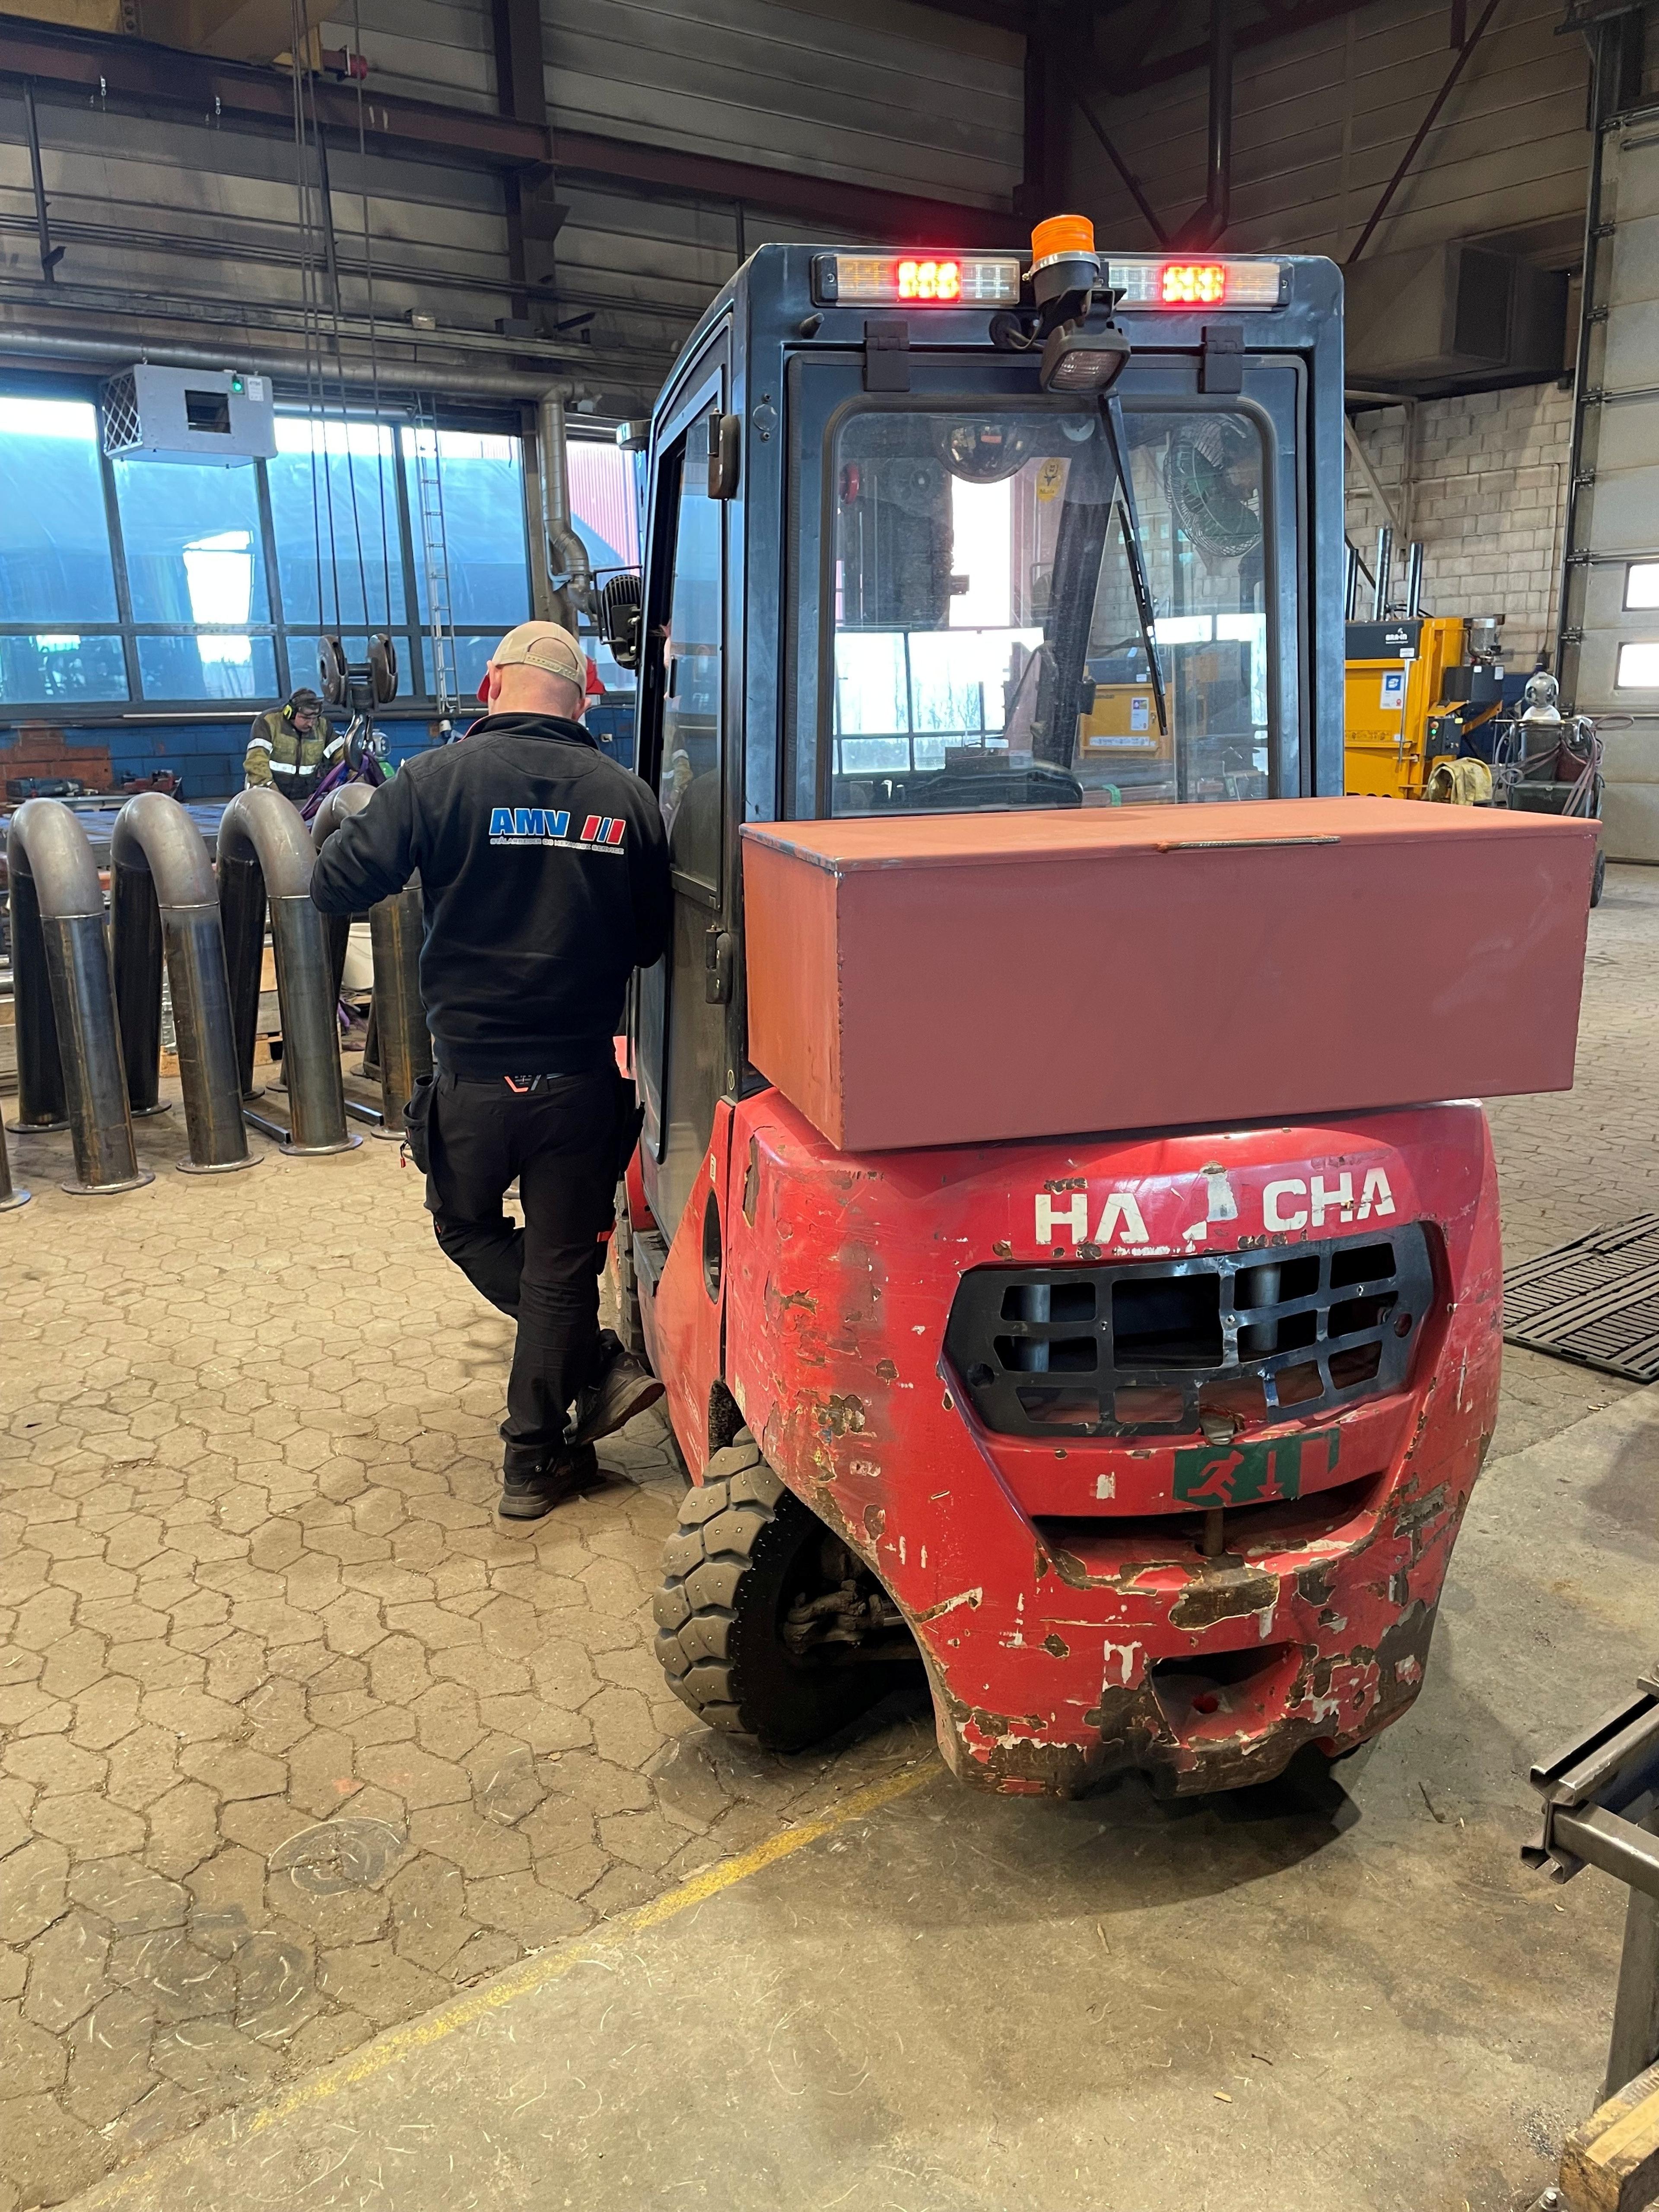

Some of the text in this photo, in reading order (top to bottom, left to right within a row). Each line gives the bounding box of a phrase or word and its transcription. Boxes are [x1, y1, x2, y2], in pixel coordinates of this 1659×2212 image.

[489, 808, 570, 837] AMV
[591, 844, 624, 855] SERVICE
[1035, 1167, 1396, 1245] HACHA
